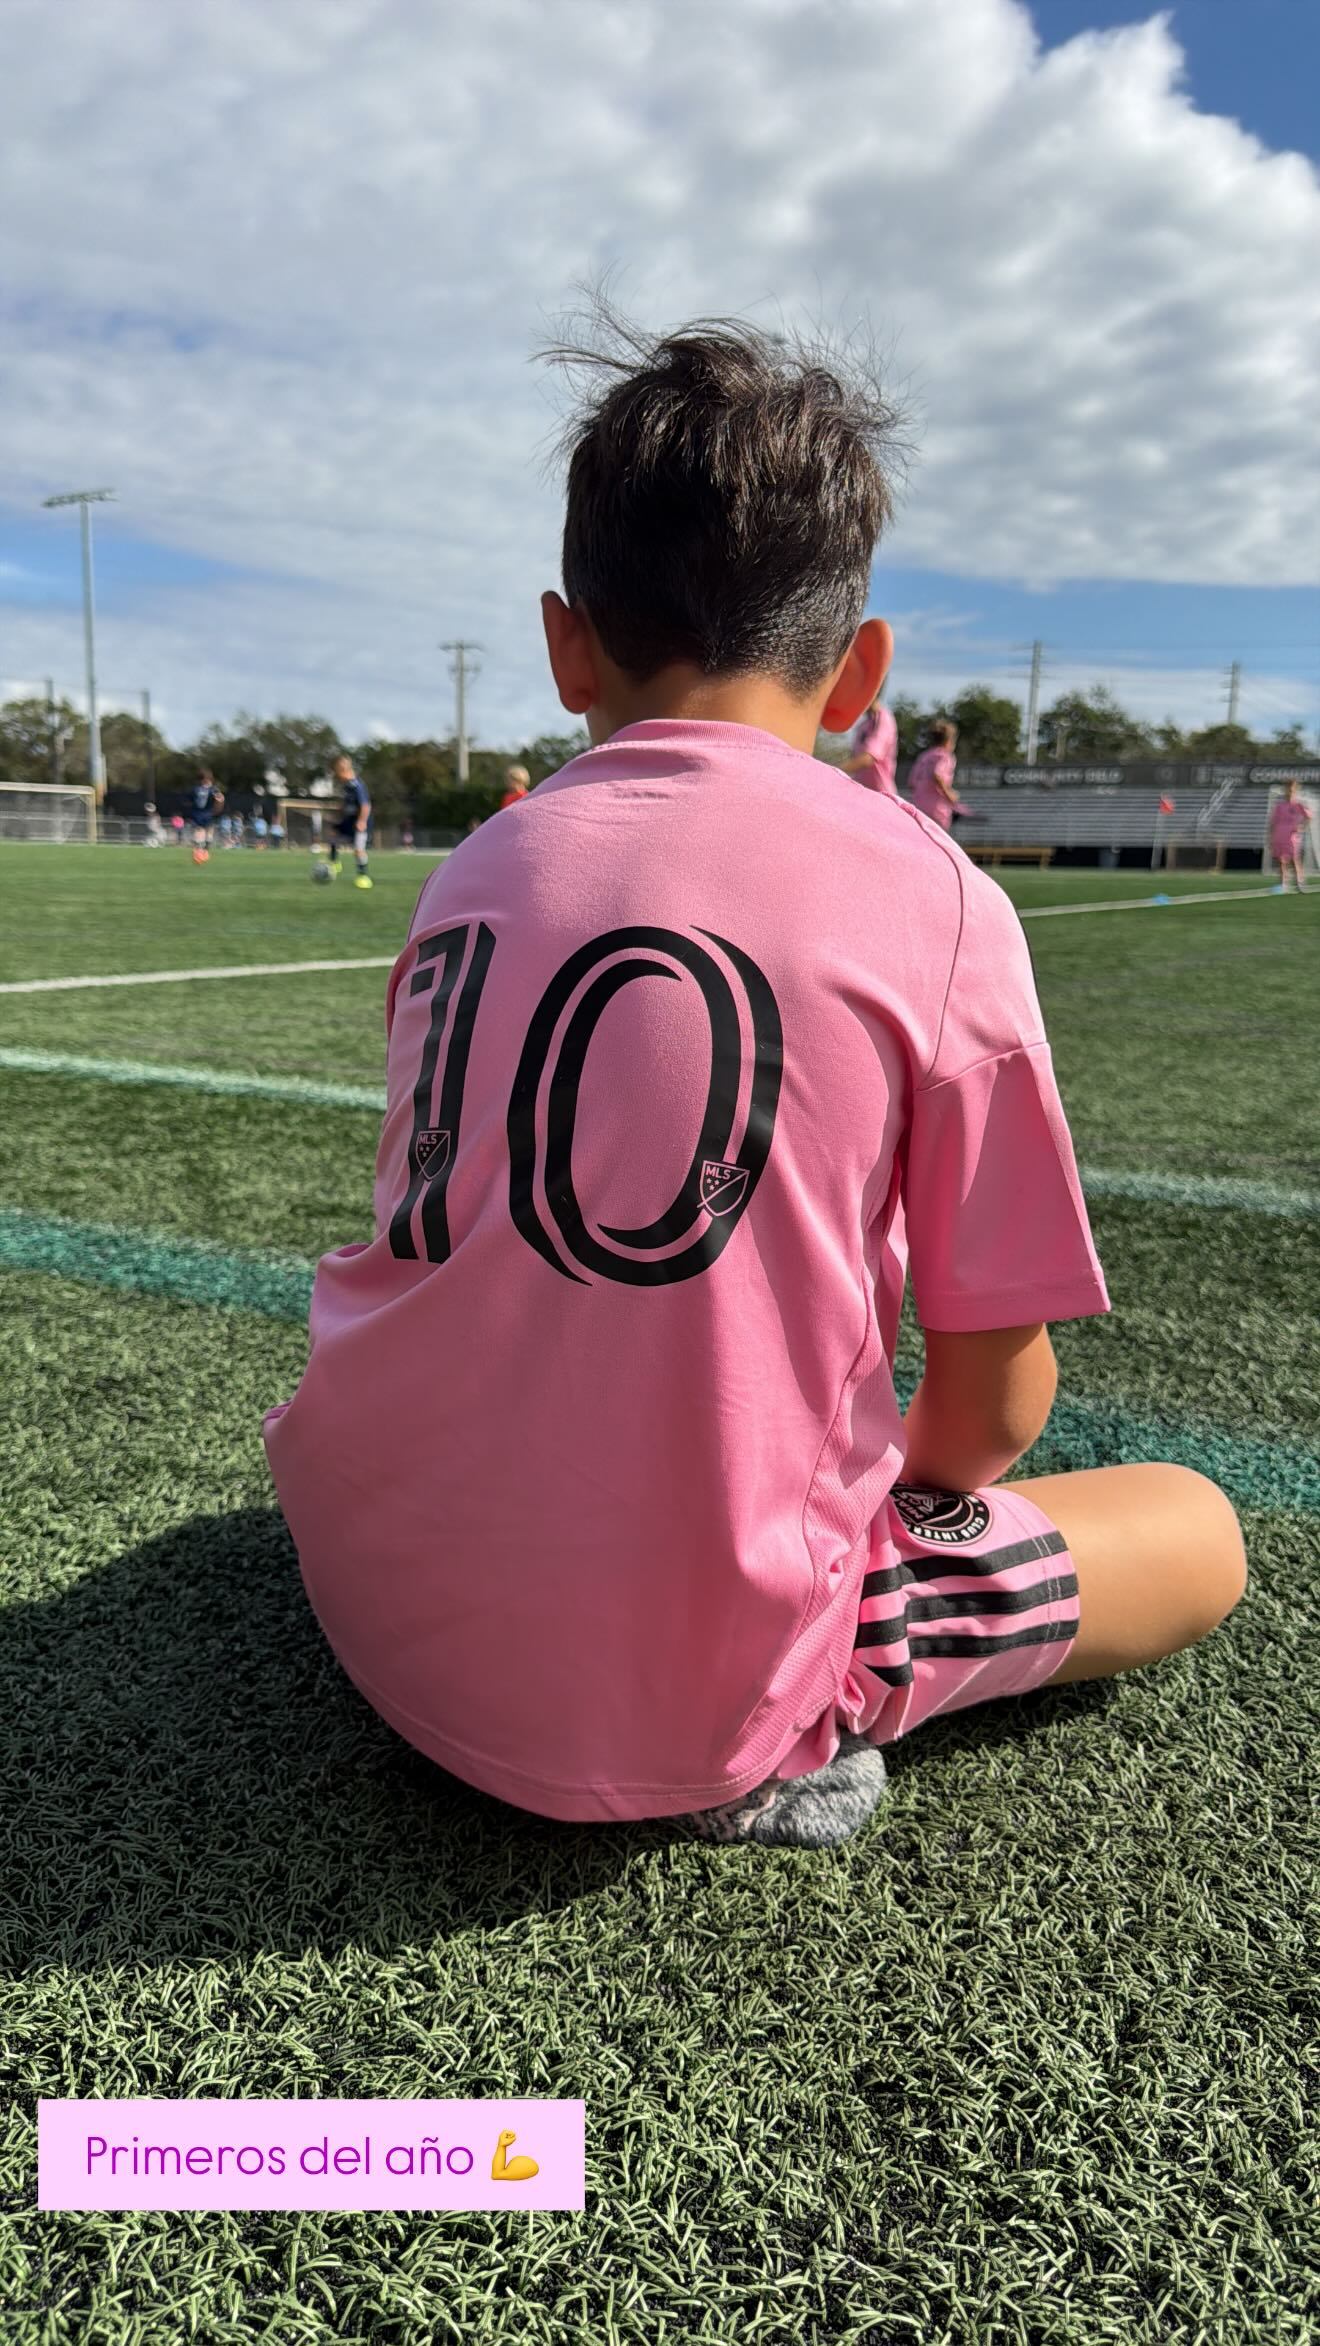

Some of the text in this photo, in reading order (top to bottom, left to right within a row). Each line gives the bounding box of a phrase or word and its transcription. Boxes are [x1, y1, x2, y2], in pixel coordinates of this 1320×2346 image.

[389, 921, 784, 1287] 10
[419, 1134, 437, 1145] MLS
[705, 1165, 731, 1180] MLS
[960, 1516, 986, 1539] CLUB
